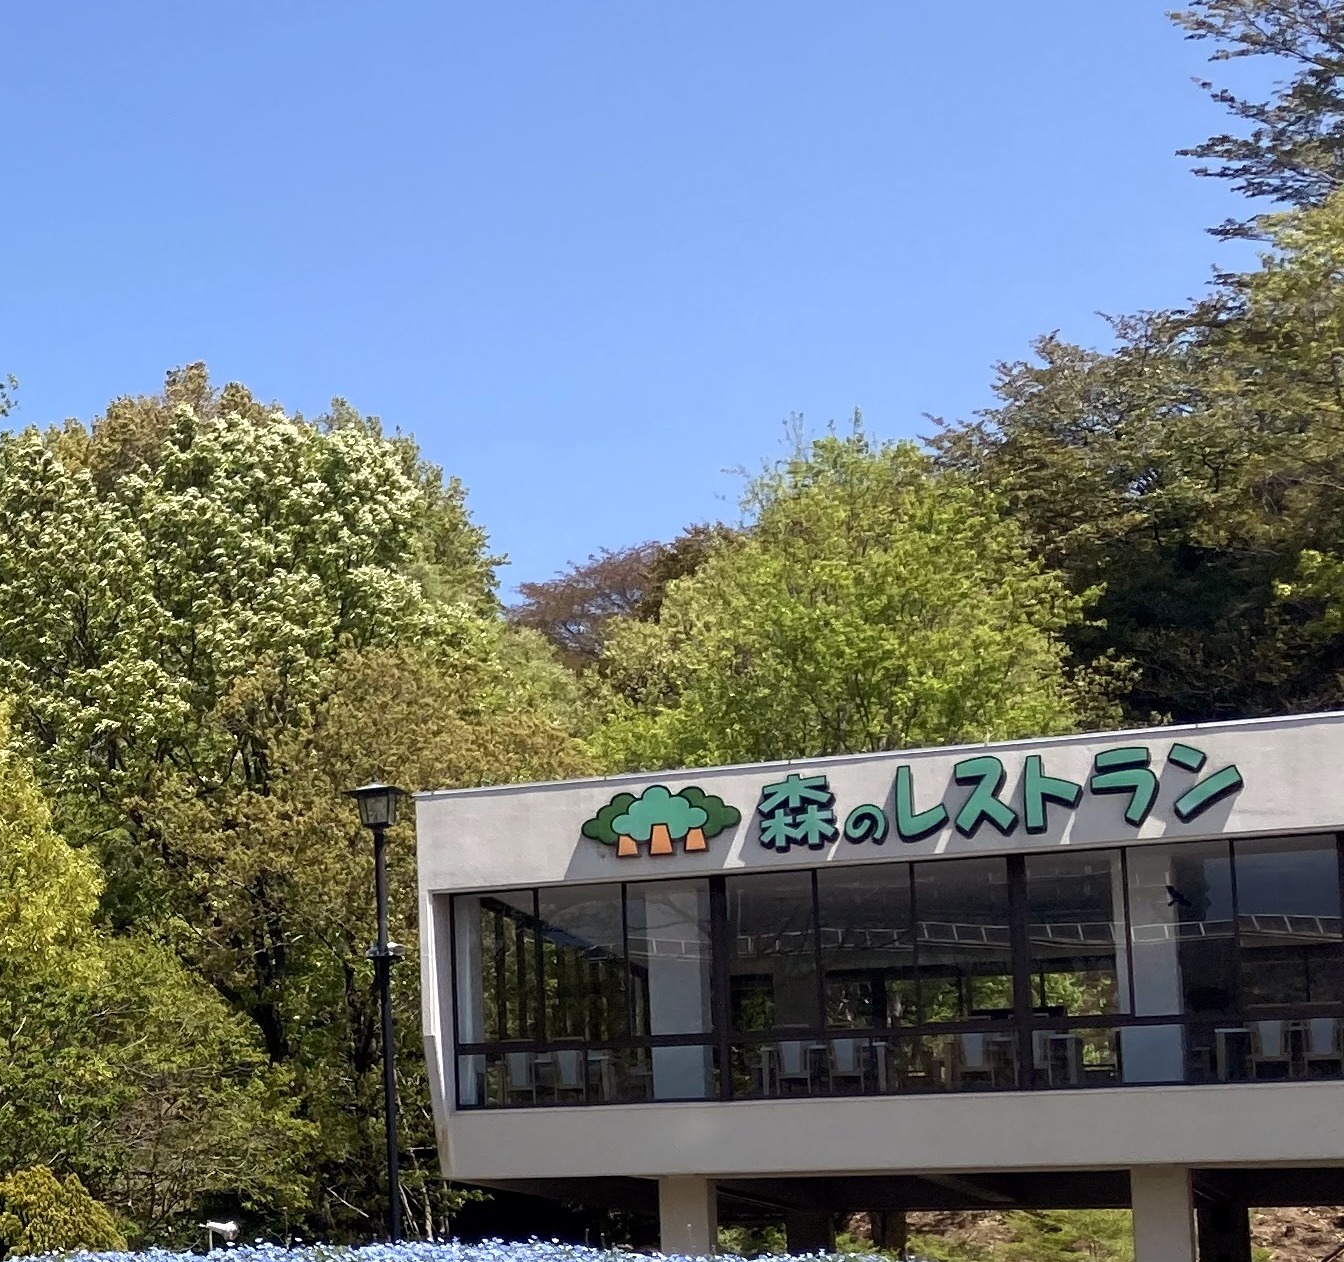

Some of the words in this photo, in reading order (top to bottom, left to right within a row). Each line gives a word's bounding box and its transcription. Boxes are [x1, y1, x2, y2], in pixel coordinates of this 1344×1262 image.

[758, 744, 1244, 850] 森のレストラン
